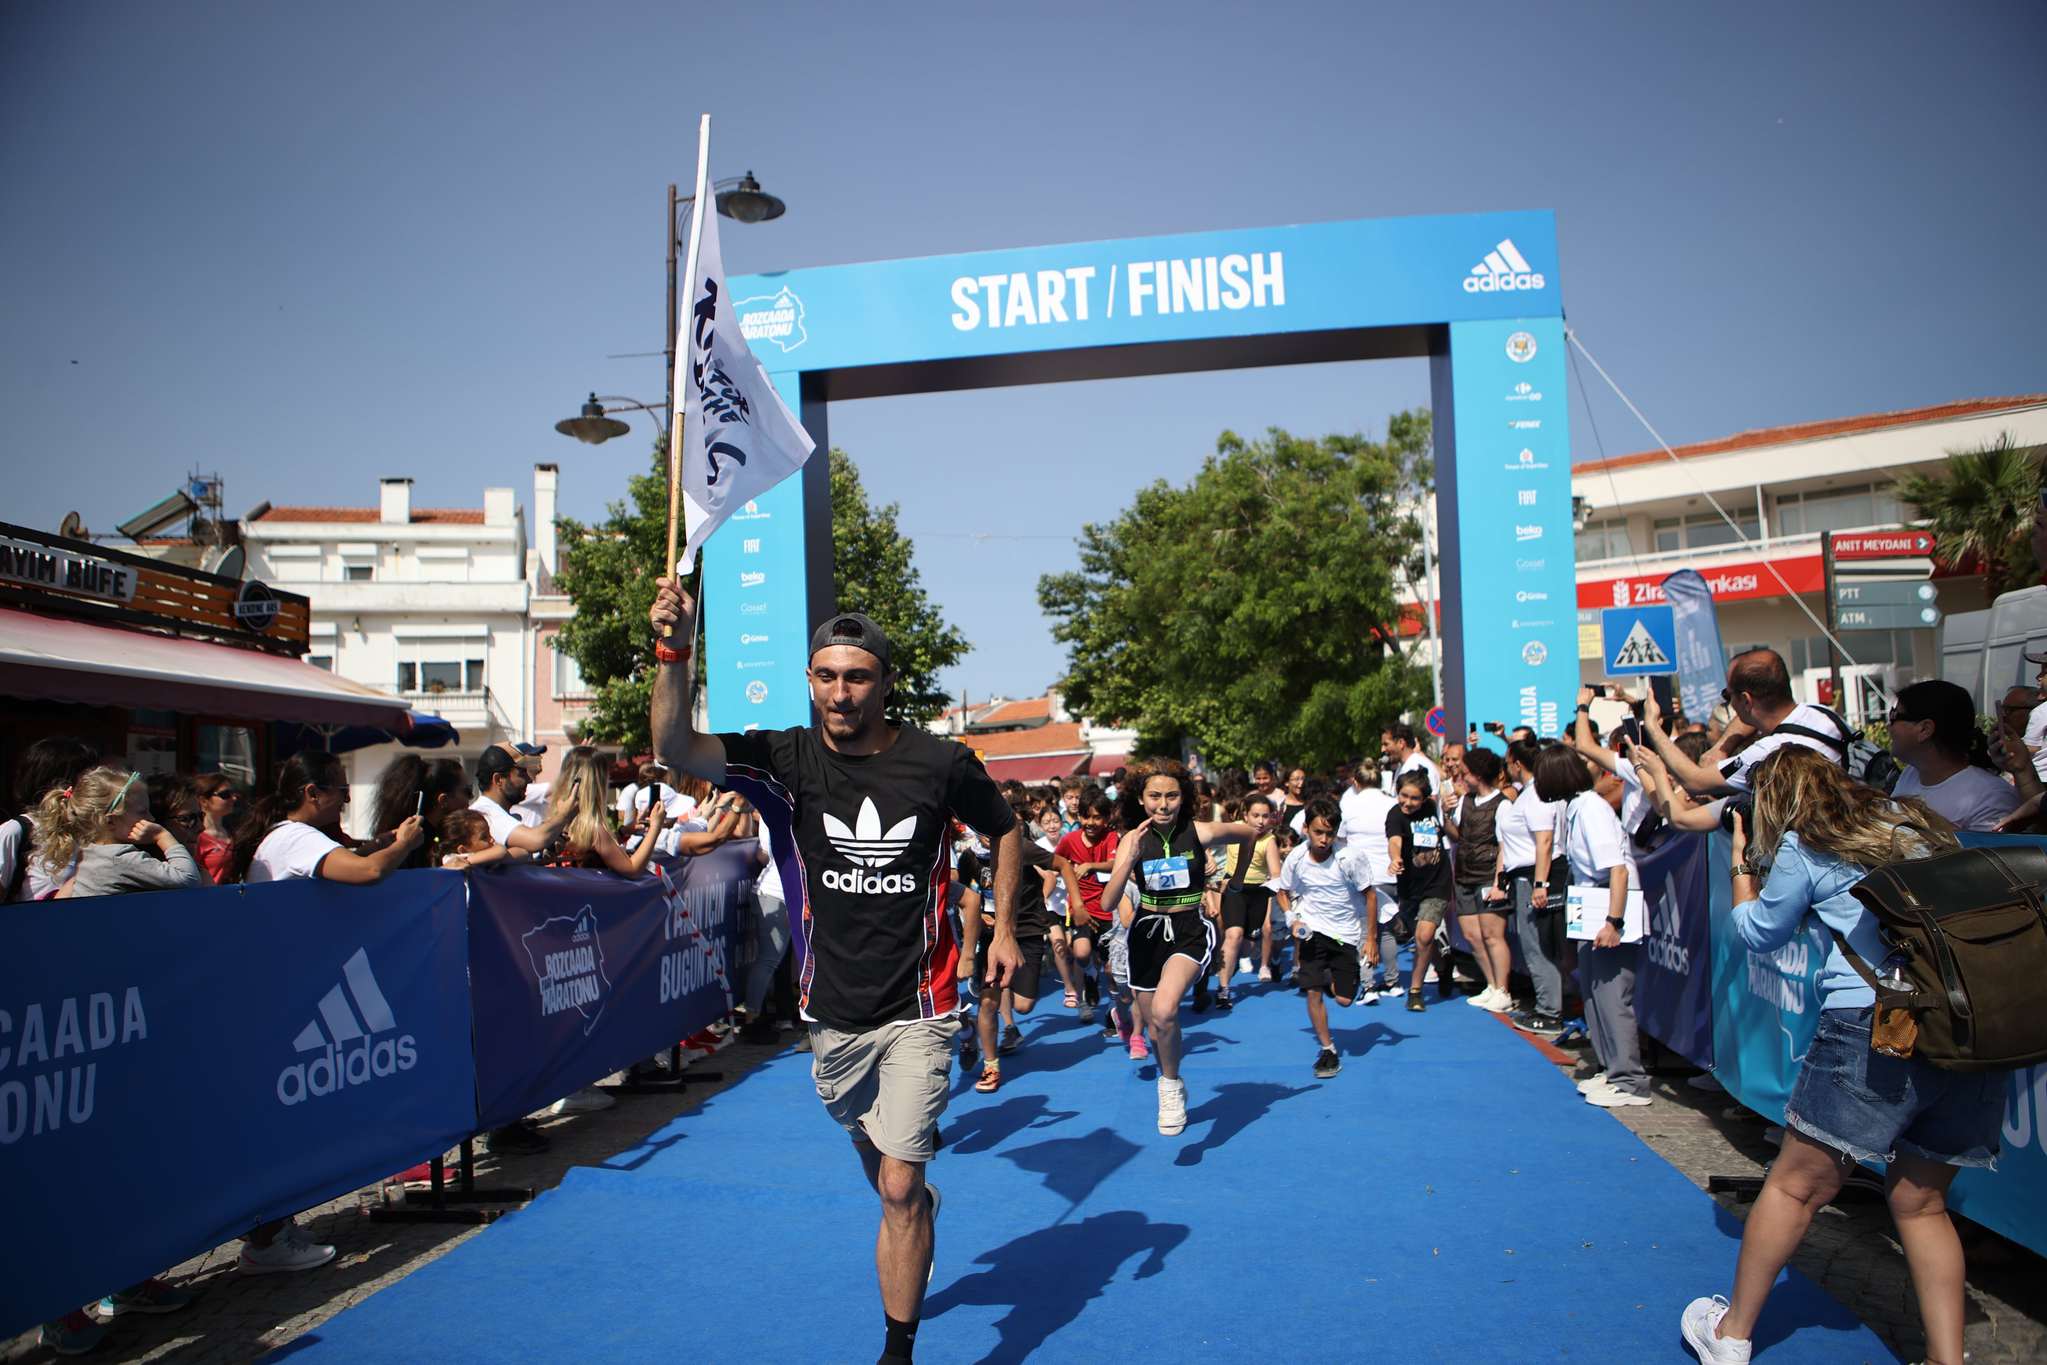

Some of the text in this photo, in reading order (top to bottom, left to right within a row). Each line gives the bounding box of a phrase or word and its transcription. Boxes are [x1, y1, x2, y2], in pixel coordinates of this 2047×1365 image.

[951, 266, 1096, 331] START
[1128, 251, 1286, 317] FINISH
[1463, 271, 1546, 293] adidas
[1515, 524, 1543, 537] beko
[741, 571, 765, 582] beko
[1634, 573, 1758, 603] Zira nkası
[1838, 587, 1860, 600] PTT
[1840, 611, 1866, 625] ATM
[822, 868, 916, 894] adidas
[1160, 874, 1176, 888] 21
[545, 944, 596, 981] BOZCAADA
[1648, 932, 1690, 976] adidas
[542, 974, 600, 1017] MARATONU
[276, 1033, 417, 1106] adidas
